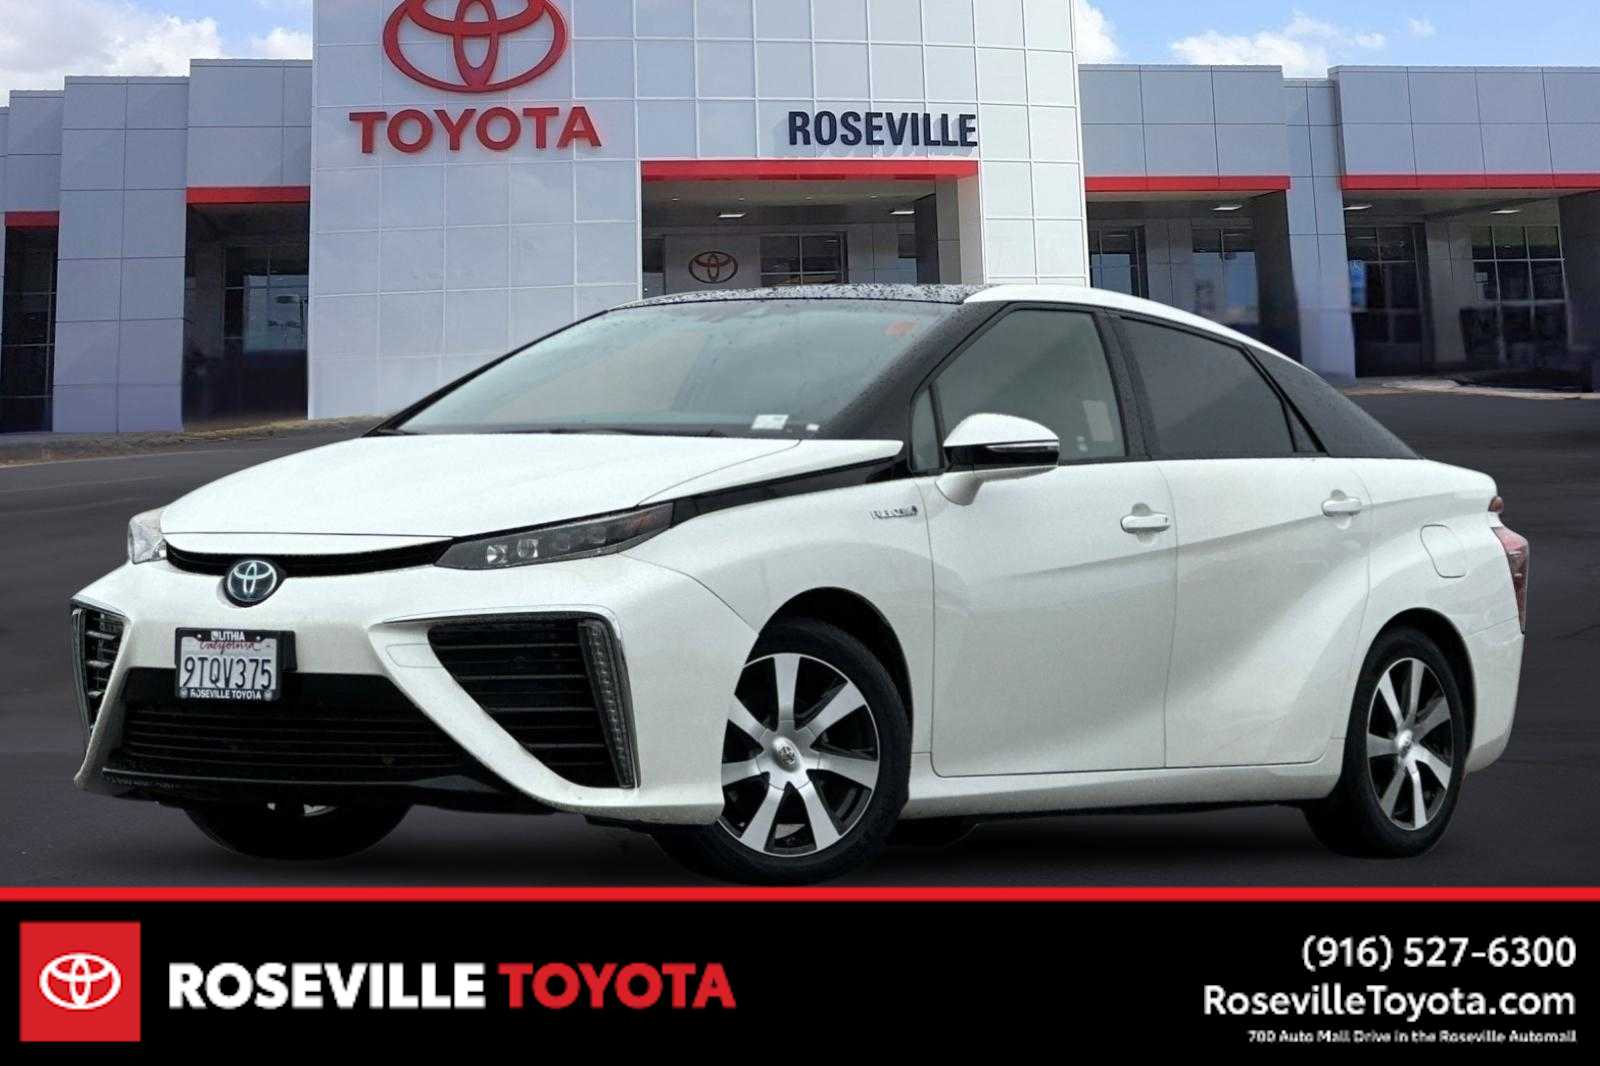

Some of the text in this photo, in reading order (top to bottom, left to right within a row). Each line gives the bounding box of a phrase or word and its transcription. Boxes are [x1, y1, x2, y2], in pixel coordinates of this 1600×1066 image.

[350, 106, 602, 154] TOYOTA
[788, 111, 978, 147] ROSEVILLE
[219, 630, 246, 641] LITHIA
[182, 656, 272, 690] 9TQV375
[190, 688, 262, 700] ROSEVILLE TOYOTA
